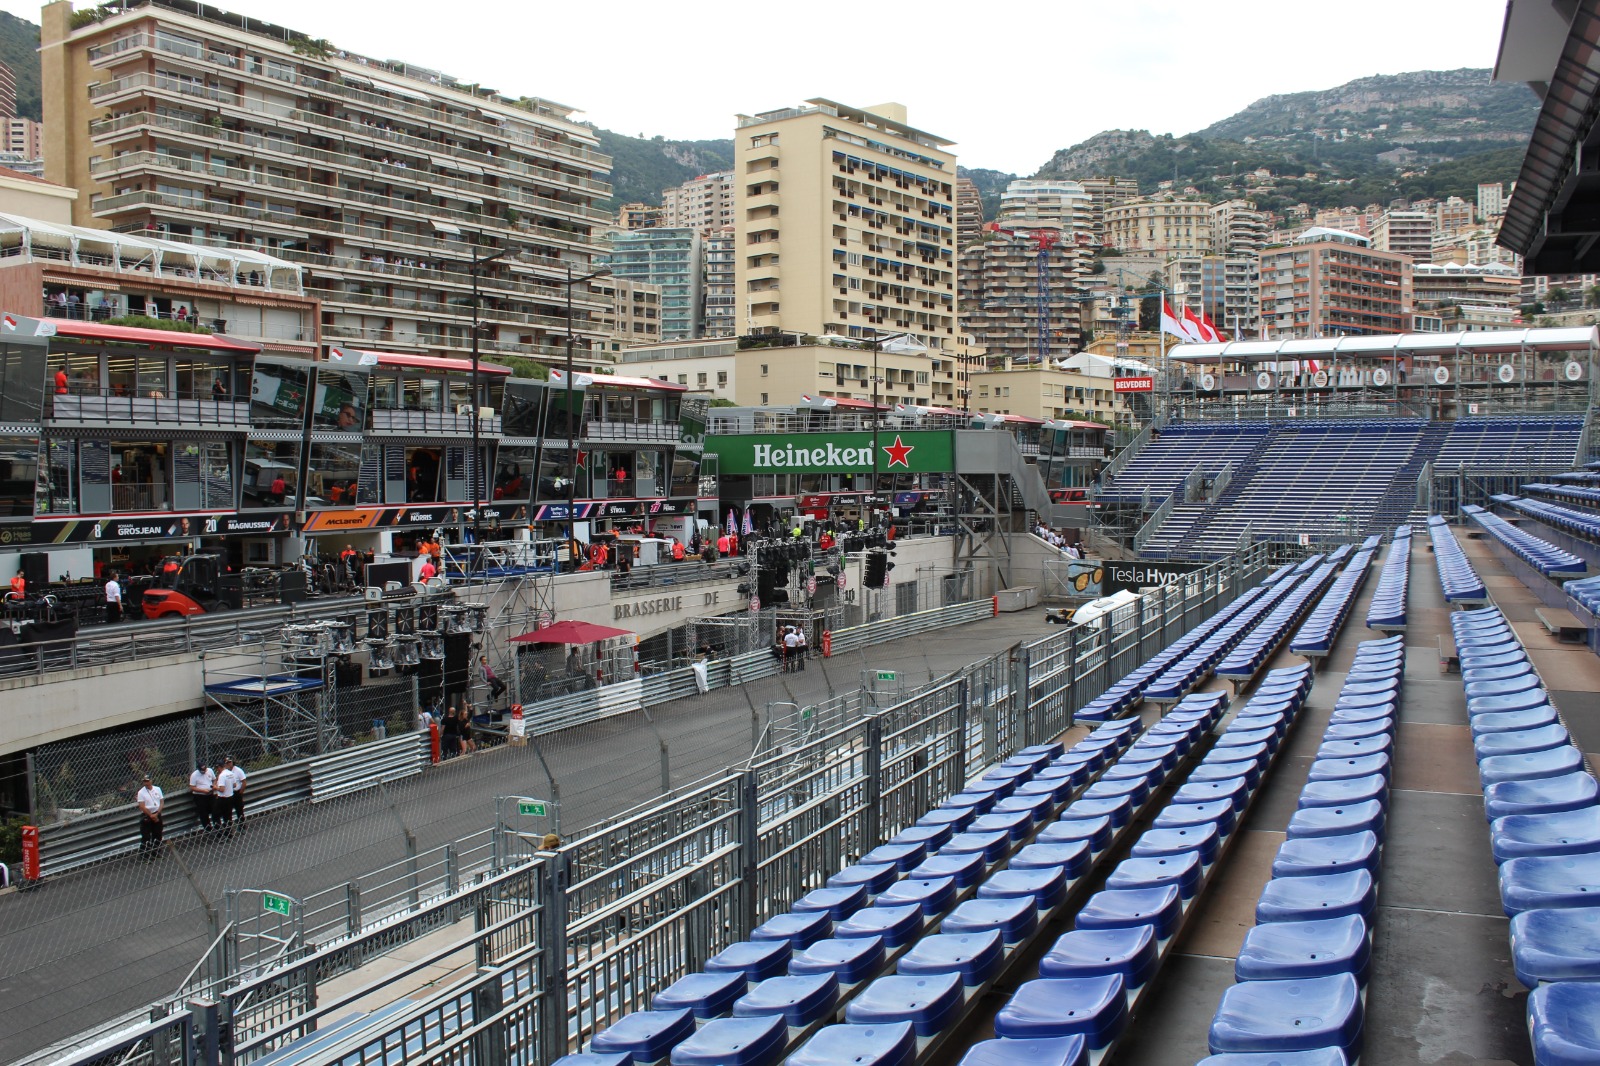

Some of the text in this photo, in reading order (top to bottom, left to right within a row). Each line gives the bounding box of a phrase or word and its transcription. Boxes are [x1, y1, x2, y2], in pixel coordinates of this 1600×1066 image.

[1115, 380, 1151, 389] BELVEDERE
[753, 443, 875, 467] Heineken
[410, 513, 433, 522] NORRIS
[94, 523, 102, 538] 8
[117, 526, 162, 536] GROSJEAN
[205, 519, 218, 533] 20
[227, 521, 271, 530] MAGNUSSEN
[1109, 566, 1144, 583] Tesla
[614, 596, 682, 620] BRASSERIE
[704, 591, 719, 606] DE
